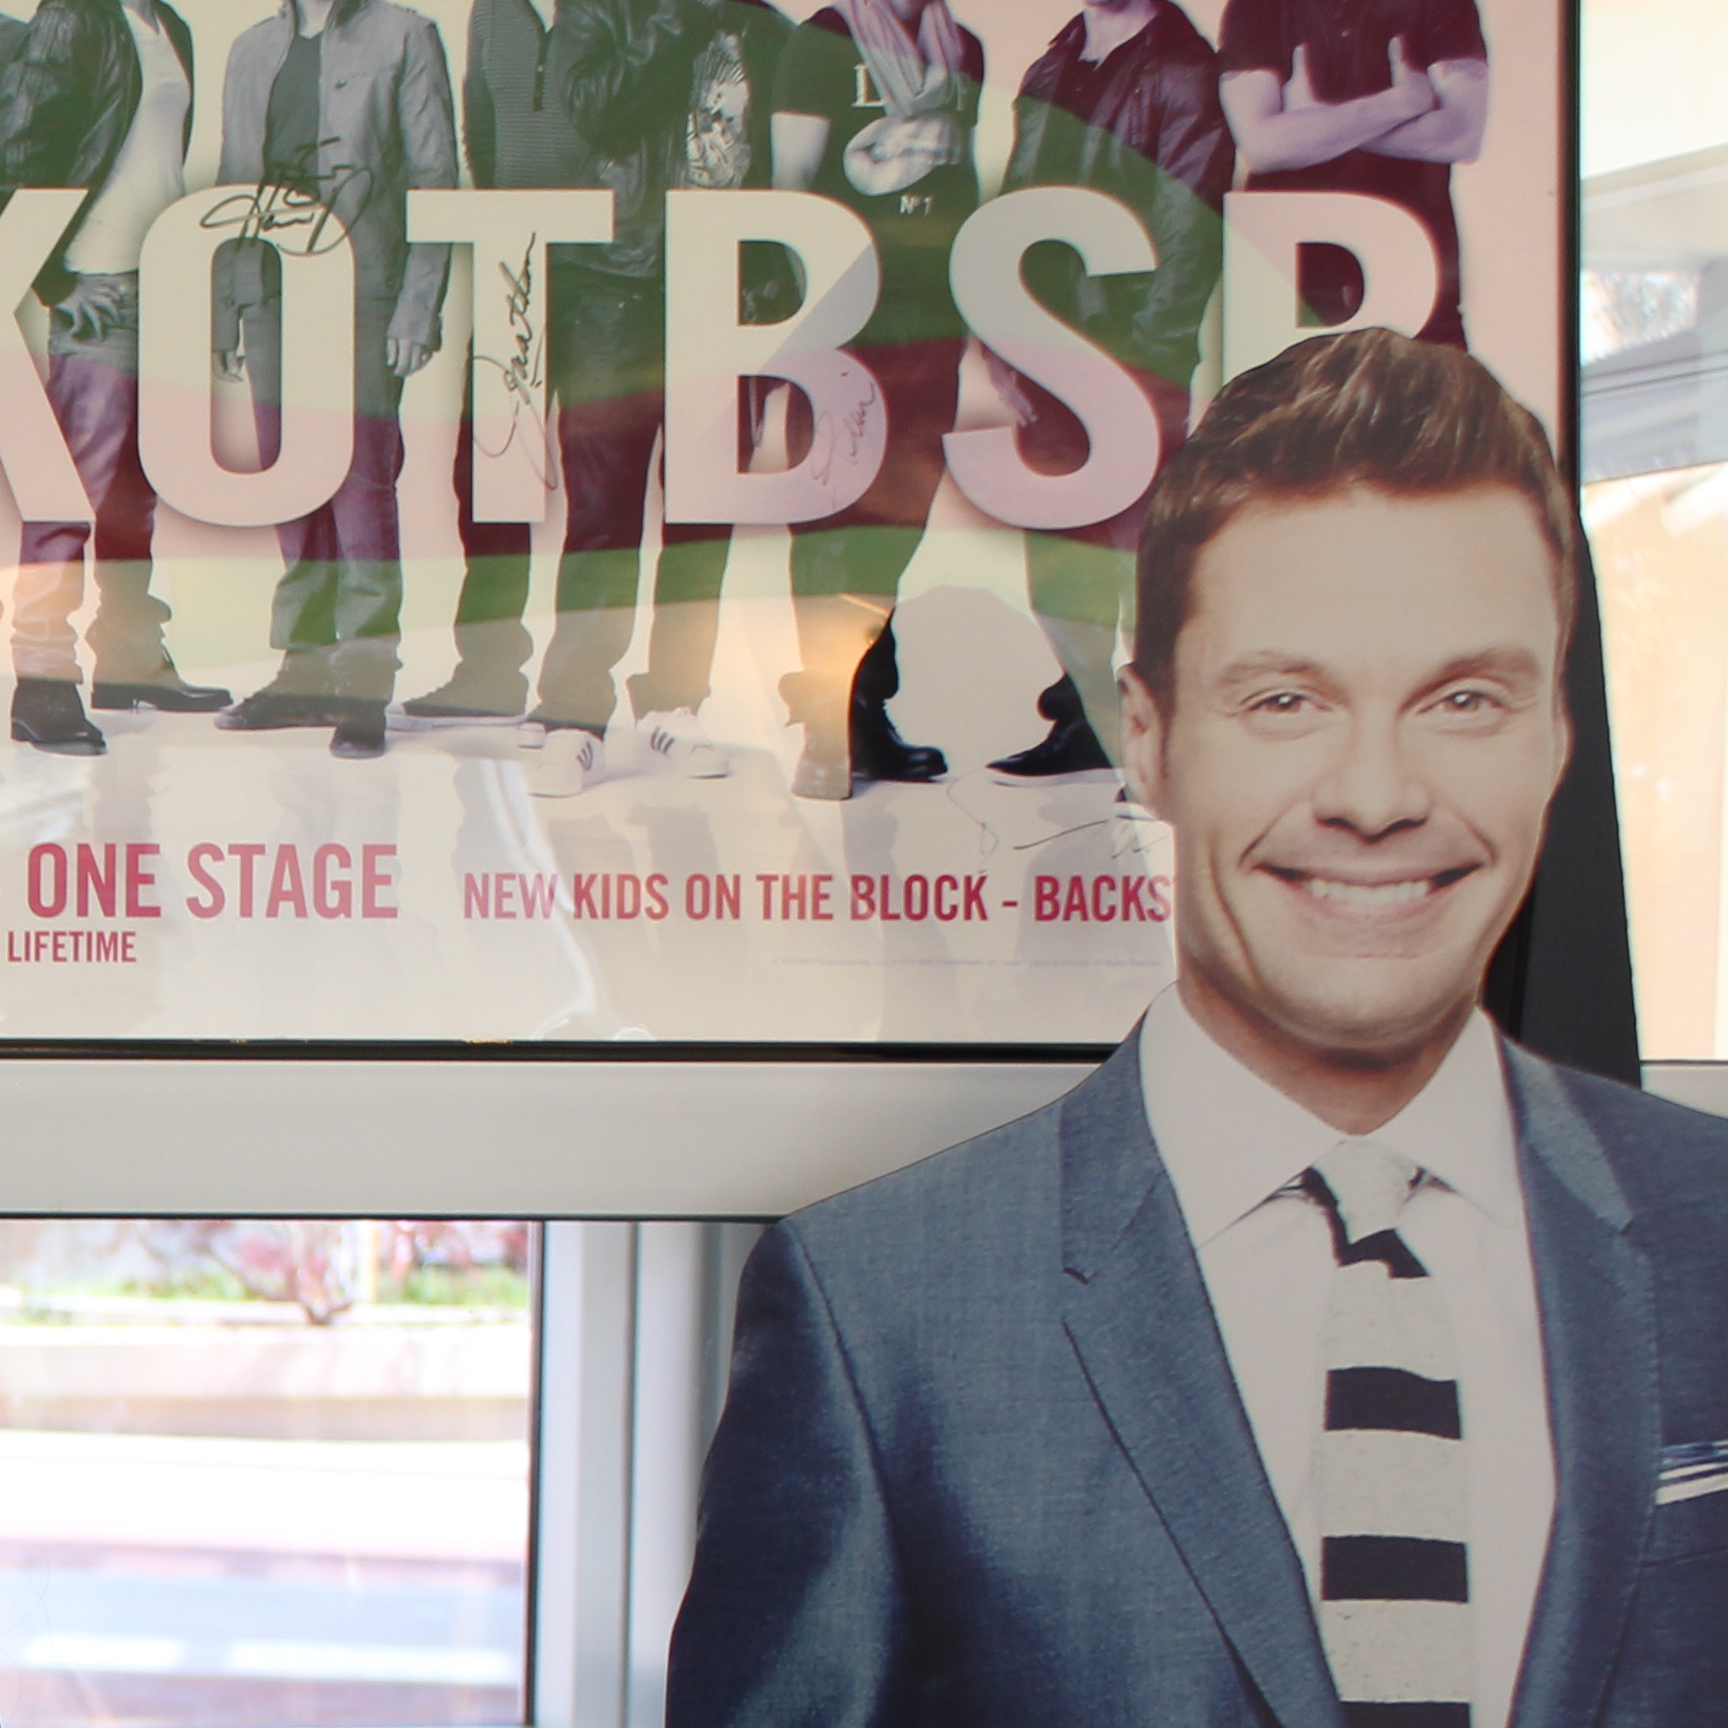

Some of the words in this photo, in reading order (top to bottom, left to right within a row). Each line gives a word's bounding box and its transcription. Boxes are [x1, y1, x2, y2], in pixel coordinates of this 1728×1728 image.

[27, 842, 162, 918] ONE
[185, 842, 399, 919] STAGE
[463, 873, 558, 920] NEW
[573, 873, 670, 921] KIDS
[684, 873, 742, 920] ON
[756, 874, 834, 920] THE
[850, 873, 988, 922] BLOCK
[1034, 873, 1171, 922] BACKS
[7, 930, 138, 963] LIFETIME
